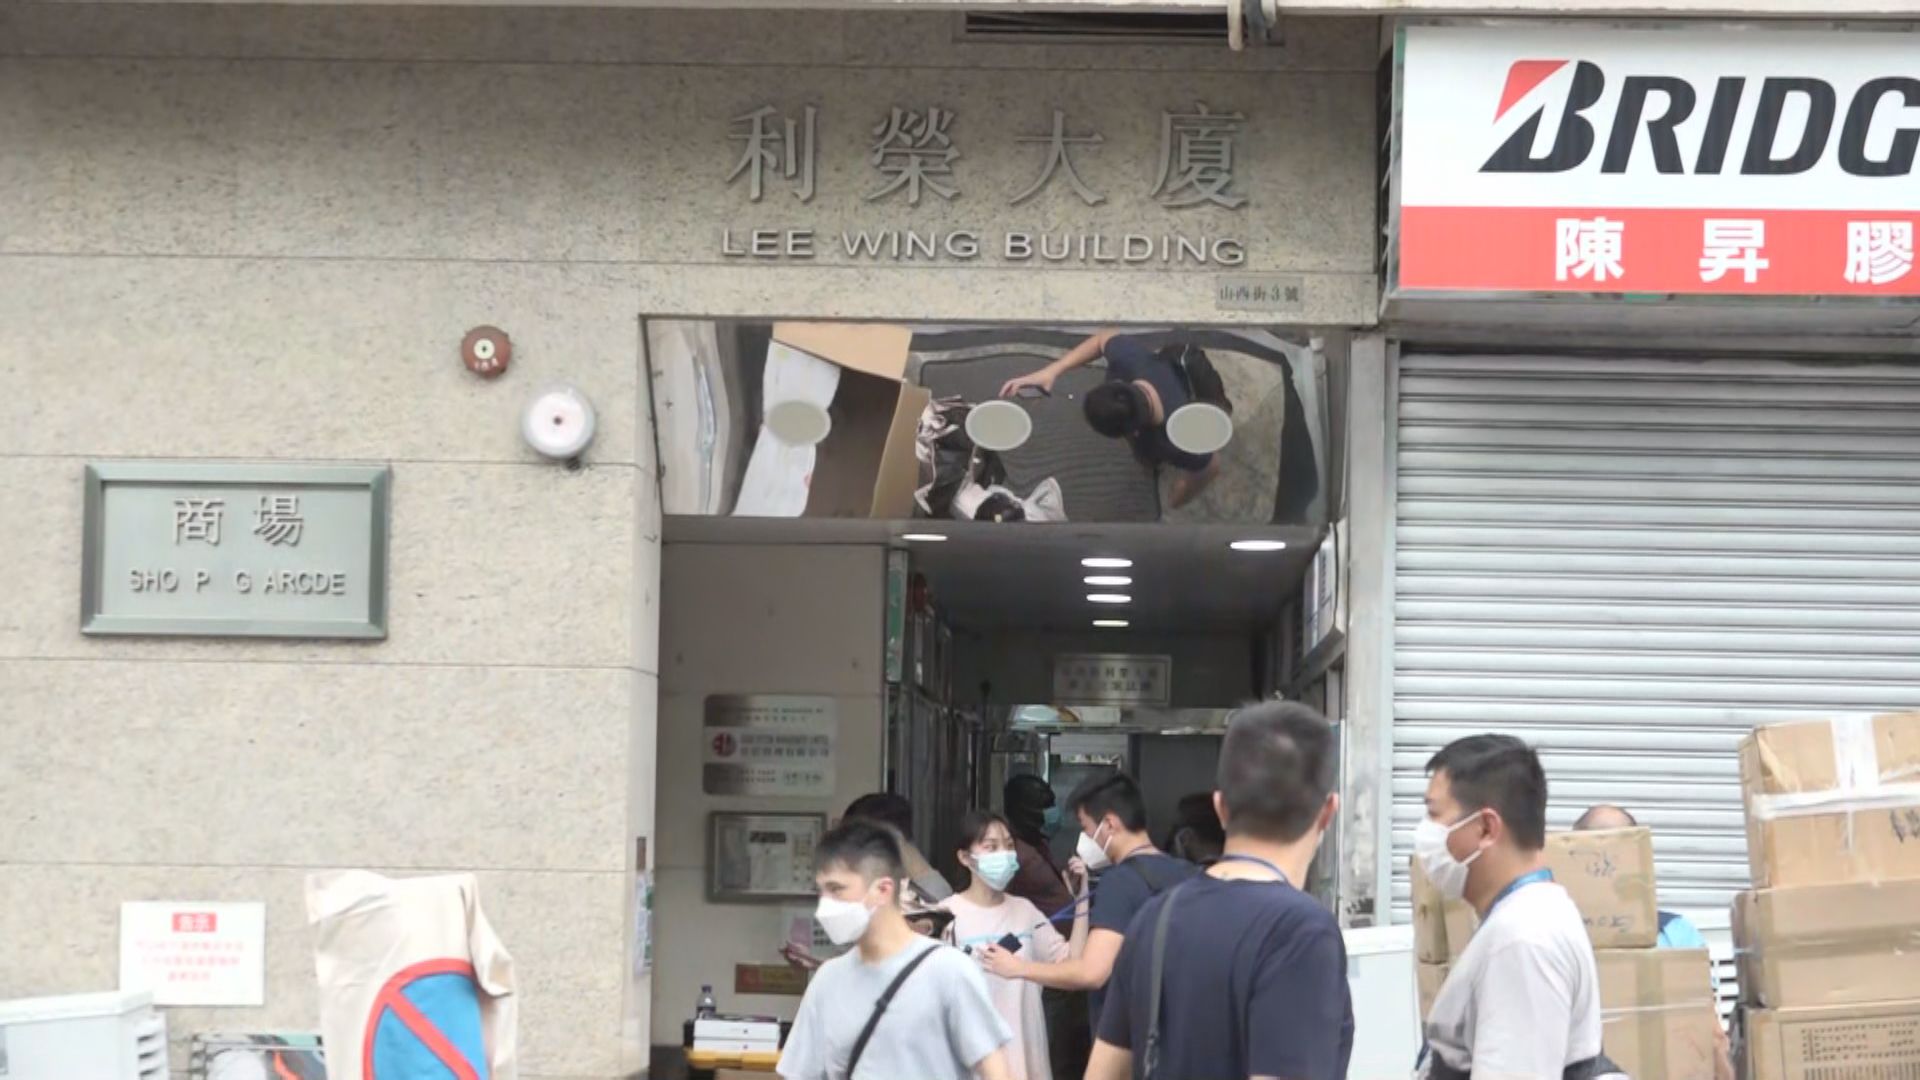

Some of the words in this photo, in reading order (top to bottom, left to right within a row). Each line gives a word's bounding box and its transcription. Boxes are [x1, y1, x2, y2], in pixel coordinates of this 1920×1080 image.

[1478, 59, 1920, 177] BRIDG
[724, 103, 1250, 210] 利榮大廈
[722, 229, 814, 259] LEE
[841, 230, 981, 260] WING
[1003, 231, 1247, 265] BUILDING
[1555, 217, 1915, 284] 陳昇膠
[173, 494, 305, 547] 商場
